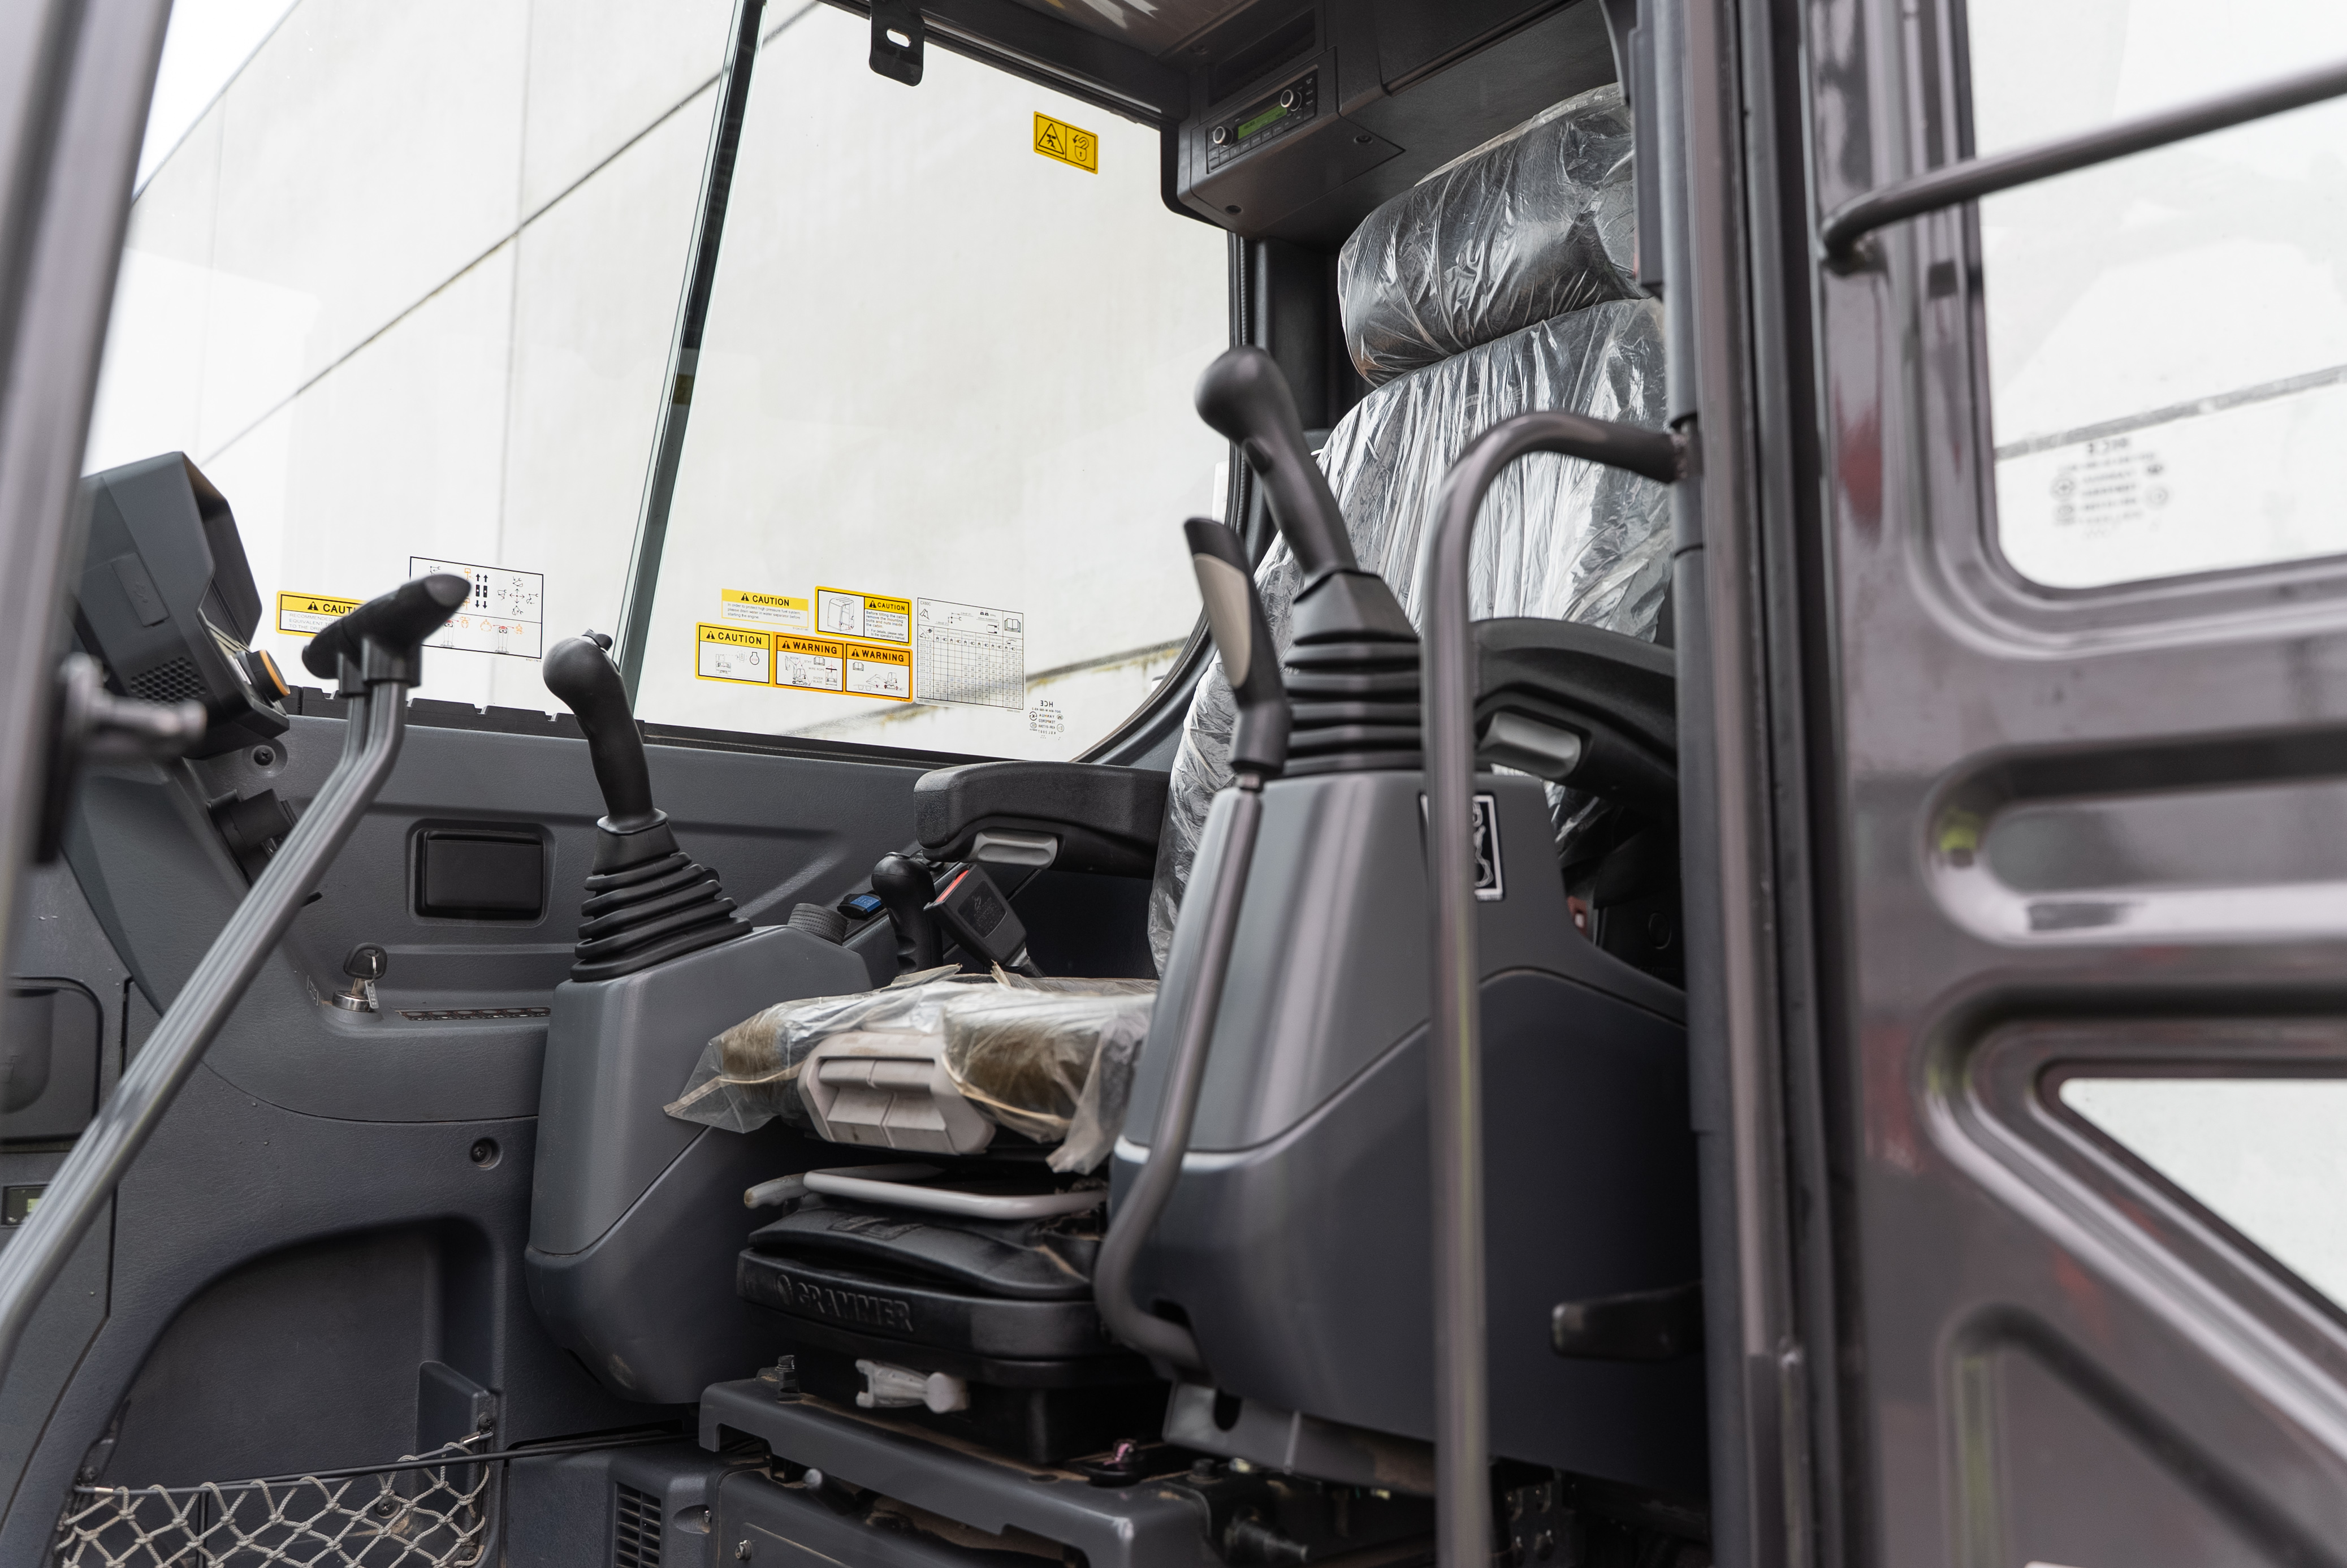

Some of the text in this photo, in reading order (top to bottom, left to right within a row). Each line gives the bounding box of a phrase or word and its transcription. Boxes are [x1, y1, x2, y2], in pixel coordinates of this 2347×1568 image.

[753, 595, 789, 606] CAUTION
[878, 602, 905, 611] CAUTION
[718, 632, 762, 645] CAUTION
[793, 641, 837, 654] WARNING
[862, 649, 904, 662] WARNING
[797, 1282, 914, 1333] GRAMMER
